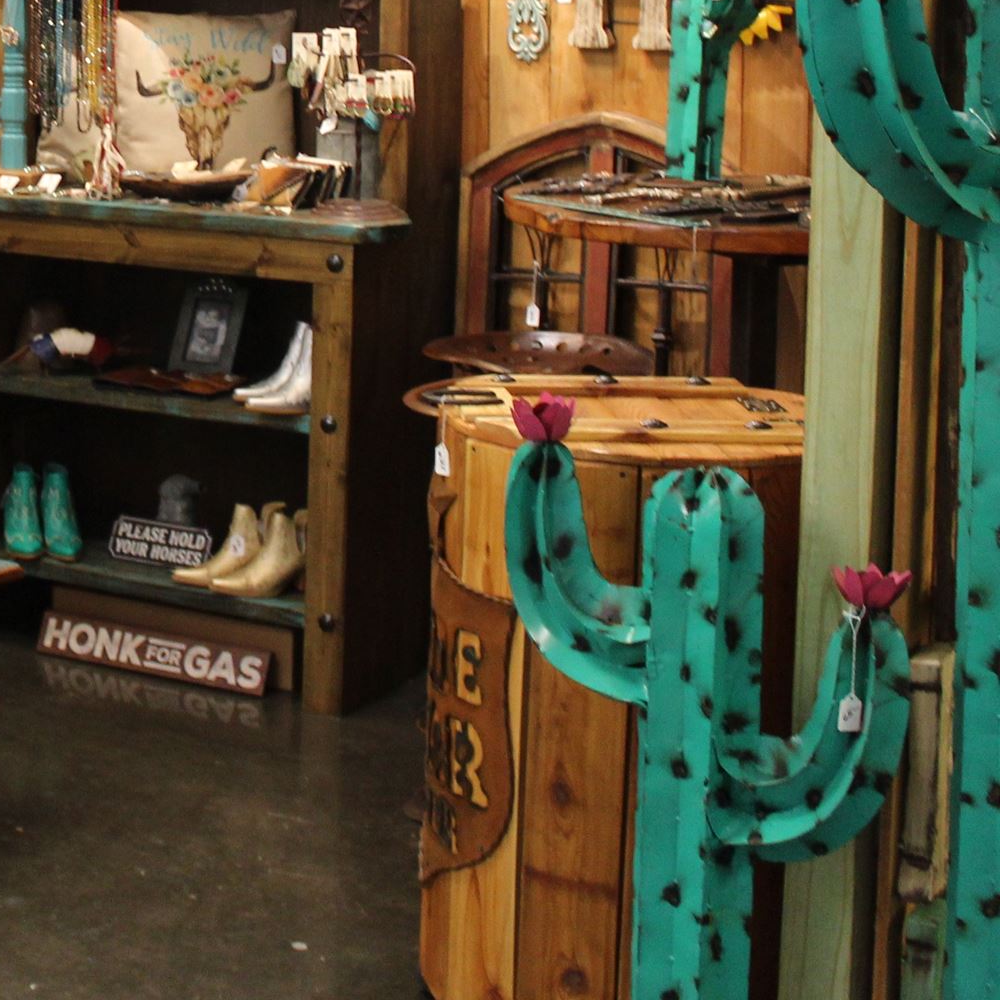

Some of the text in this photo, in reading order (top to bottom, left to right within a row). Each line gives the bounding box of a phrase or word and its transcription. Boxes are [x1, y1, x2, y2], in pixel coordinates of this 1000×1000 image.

[117, 521, 206, 549] PLEASE HOLD
[115, 538, 202, 567] YOUR HORSES
[43, 617, 263, 690] HONK FOR GAS
